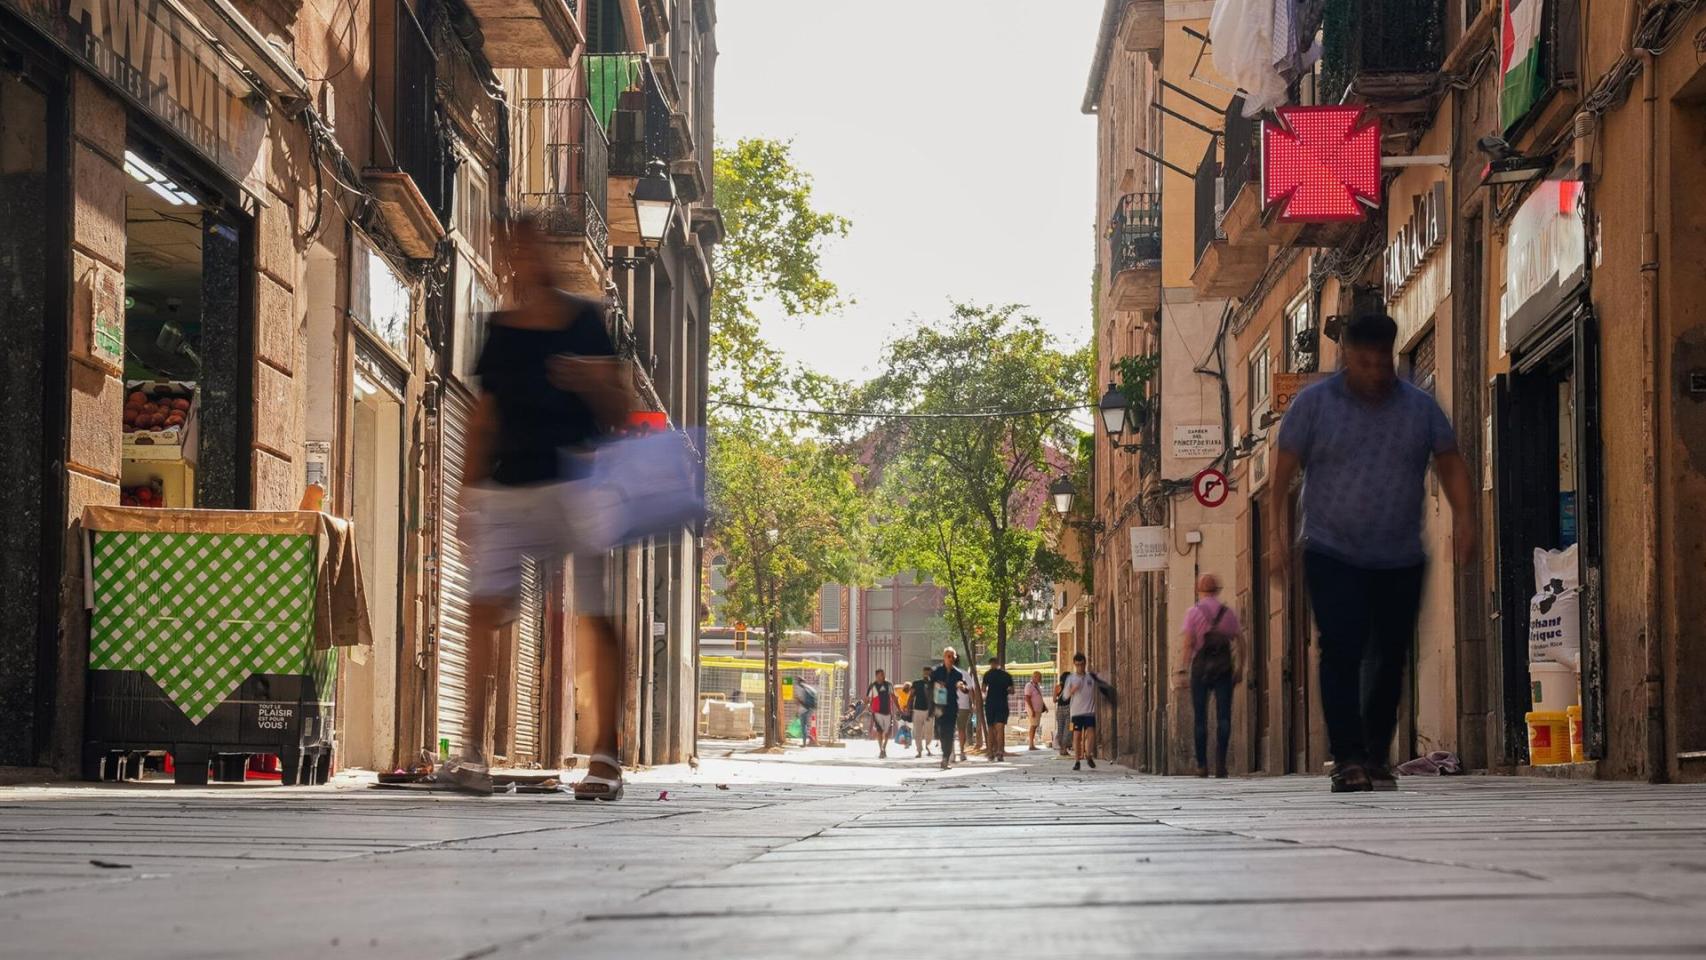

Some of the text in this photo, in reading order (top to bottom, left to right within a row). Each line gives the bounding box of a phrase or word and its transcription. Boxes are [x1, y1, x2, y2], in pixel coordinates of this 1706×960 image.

[85, 34, 142, 99] FRUITES
[158, 91, 217, 158] VERDURES
[1383, 181, 1445, 306] FARMACIA
[258, 709, 293, 717] PLAISIR
[258, 721, 283, 729] VOUS
